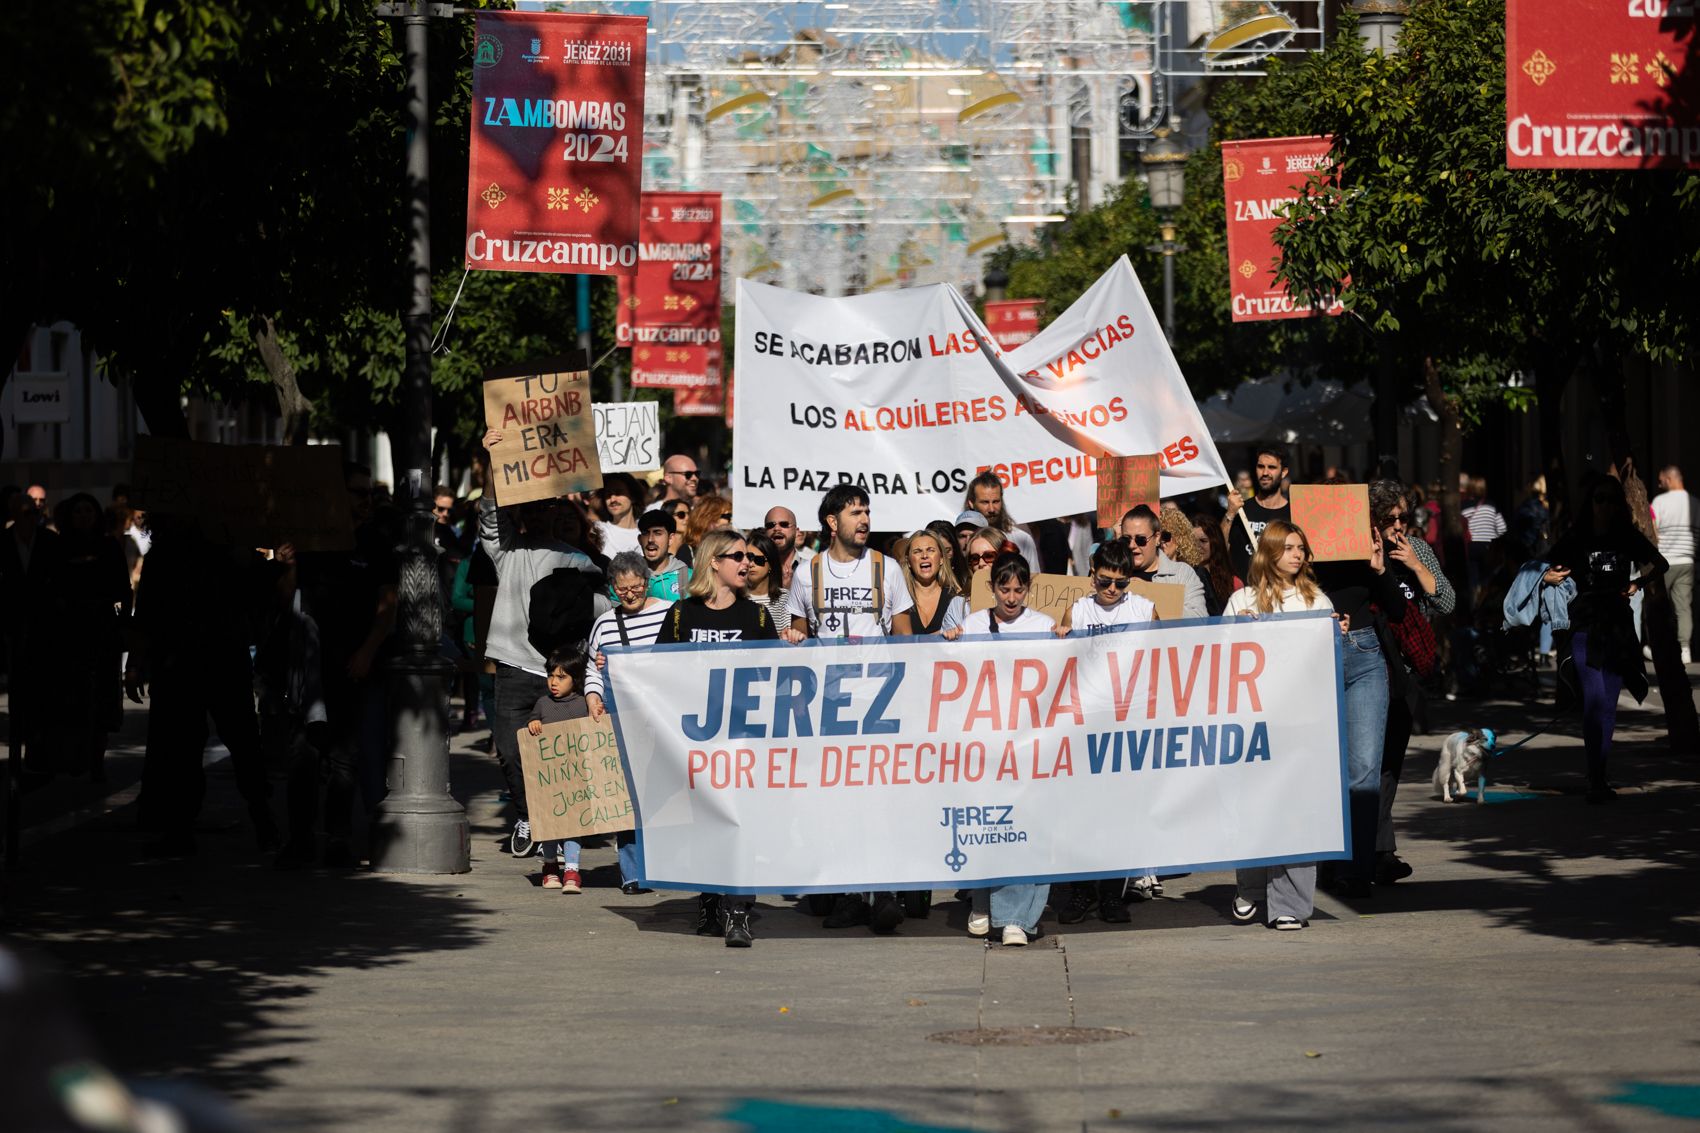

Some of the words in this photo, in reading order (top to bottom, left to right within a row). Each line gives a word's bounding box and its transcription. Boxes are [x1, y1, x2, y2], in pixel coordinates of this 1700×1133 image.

[564, 45, 601, 60] JEREZ
[603, 46, 631, 62] 2031
[484, 97, 626, 131] ZAMBOMBAS
[563, 133, 628, 163] 2024
[1286, 158, 1312, 170] JEREZ
[467, 230, 637, 270] Cruzcampo
[638, 243, 711, 261] AMBOMBAS
[672, 263, 713, 280] 2024
[617, 322, 720, 345] Cruzcampo
[755, 331, 784, 357] SE
[790, 337, 922, 365] ACABARON
[928, 329, 981, 357] LAS
[1046, 315, 1135, 379] VACÍAS
[515, 373, 558, 398] TU
[631, 368, 707, 387] Cruzcampo
[22, 390, 60, 403] Lowi
[502, 391, 582, 429] AIRBNB
[593, 405, 656, 438] DEJAN
[791, 402, 837, 428] LOS
[522, 422, 569, 451] ERA
[600, 435, 652, 465] ASAS
[503, 460, 530, 485] MI
[530, 448, 589, 478] CASA
[744, 466, 775, 489] LA
[784, 467, 832, 492] PAZ
[837, 472, 908, 494] PARA
[915, 468, 967, 494] LOS
[824, 587, 872, 601] JEREZ
[689, 628, 742, 642] JEREZ
[681, 661, 906, 742] JEREZ
[927, 656, 1084, 733] PARA
[1106, 641, 1266, 722] VIVIR
[538, 733, 590, 761] ECHO
[592, 731, 618, 752] DE
[688, 748, 756, 789] POR
[767, 747, 807, 788] EL
[820, 741, 986, 788] DERECHO
[996, 740, 1019, 782] A
[1031, 736, 1073, 780] LA
[1086, 721, 1271, 775] VIVIENDA
[538, 759, 593, 787] NIÑXS
[601, 755, 621, 775] PA
[553, 785, 600, 817] JUGAR
[604, 775, 625, 797] EN
[580, 799, 634, 827] CALLE
[940, 805, 1014, 827] JEREZ
[958, 831, 1027, 846] VIVIENDA
